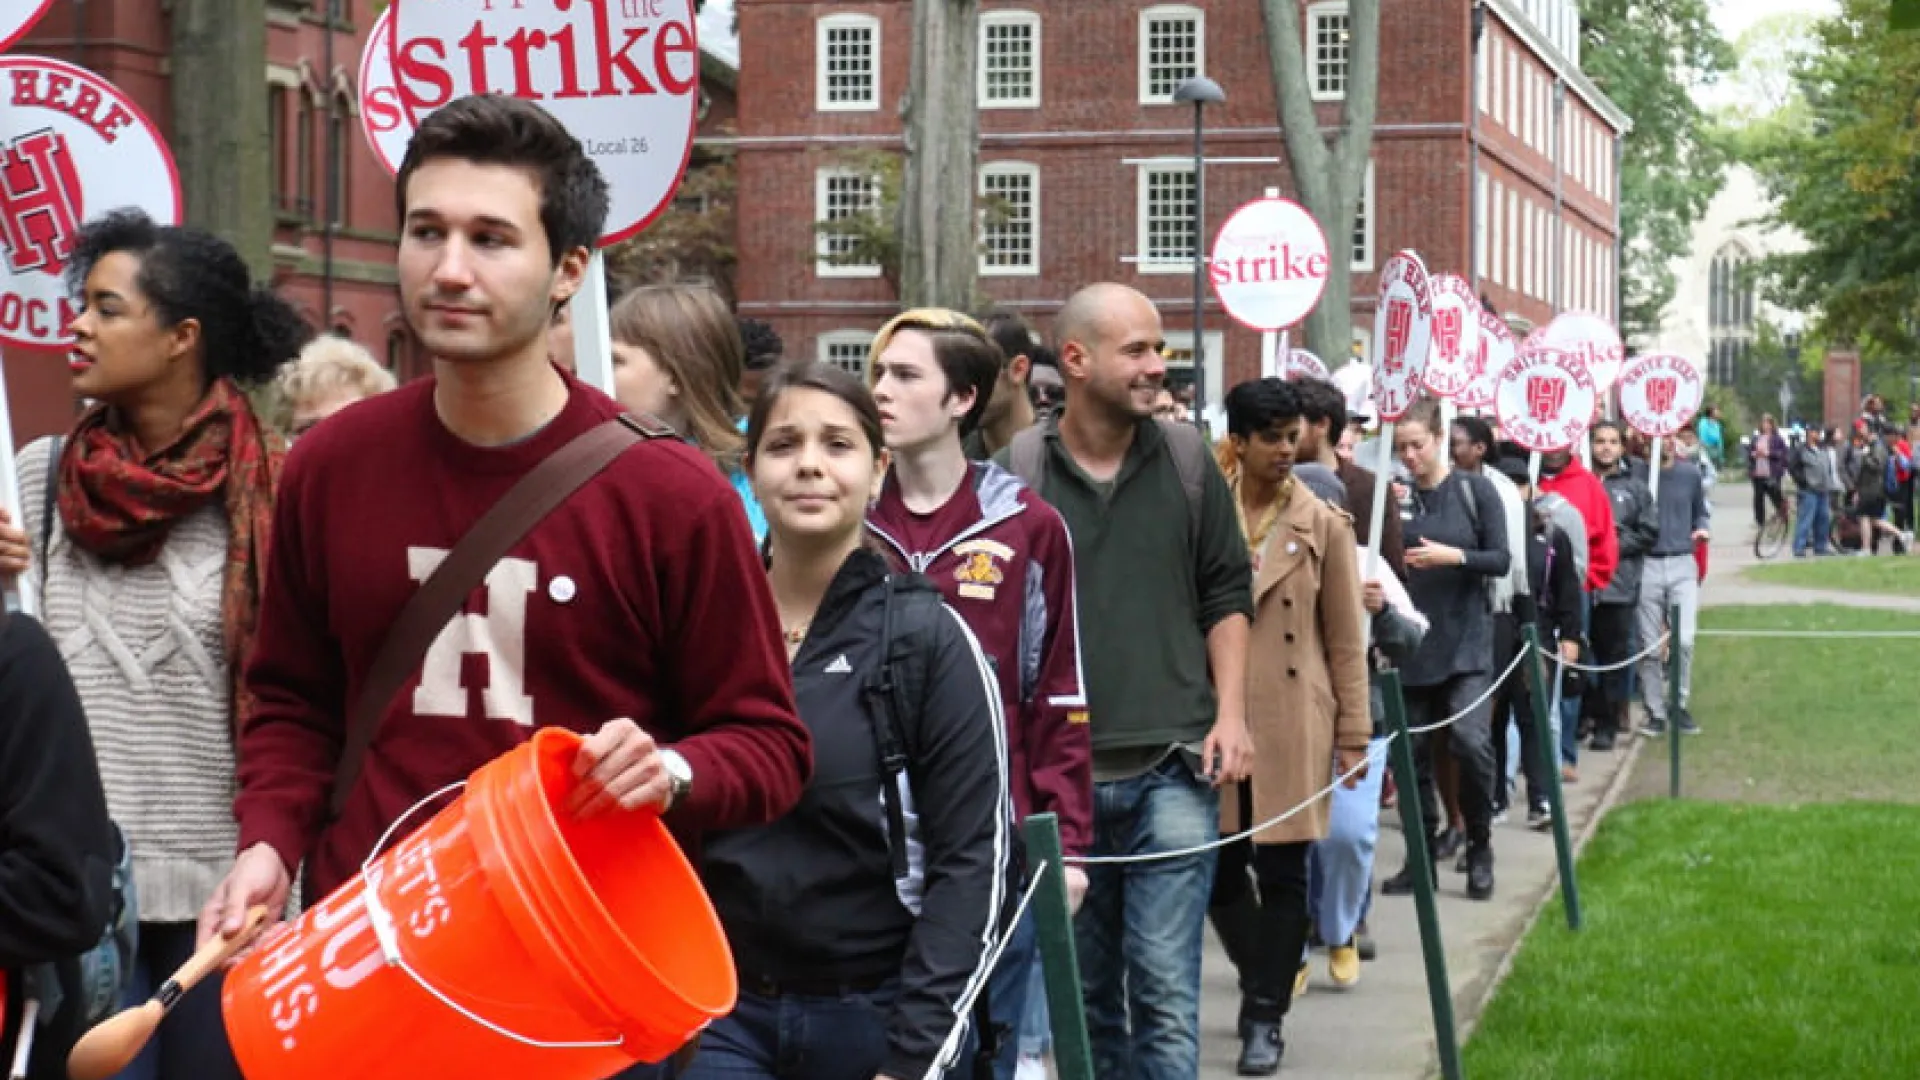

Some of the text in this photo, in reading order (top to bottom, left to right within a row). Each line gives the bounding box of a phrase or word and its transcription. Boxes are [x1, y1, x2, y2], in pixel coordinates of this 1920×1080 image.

[397, 0, 697, 109] strike
[11, 69, 133, 143] HERE
[586, 137, 649, 155] Local 26
[1210, 242, 1328, 285] strike
[1503, 350, 1549, 382] UNITE
[1555, 352, 1591, 390] HERE
[1503, 413, 1558, 447] LOCAL
[407, 546, 538, 726] H
